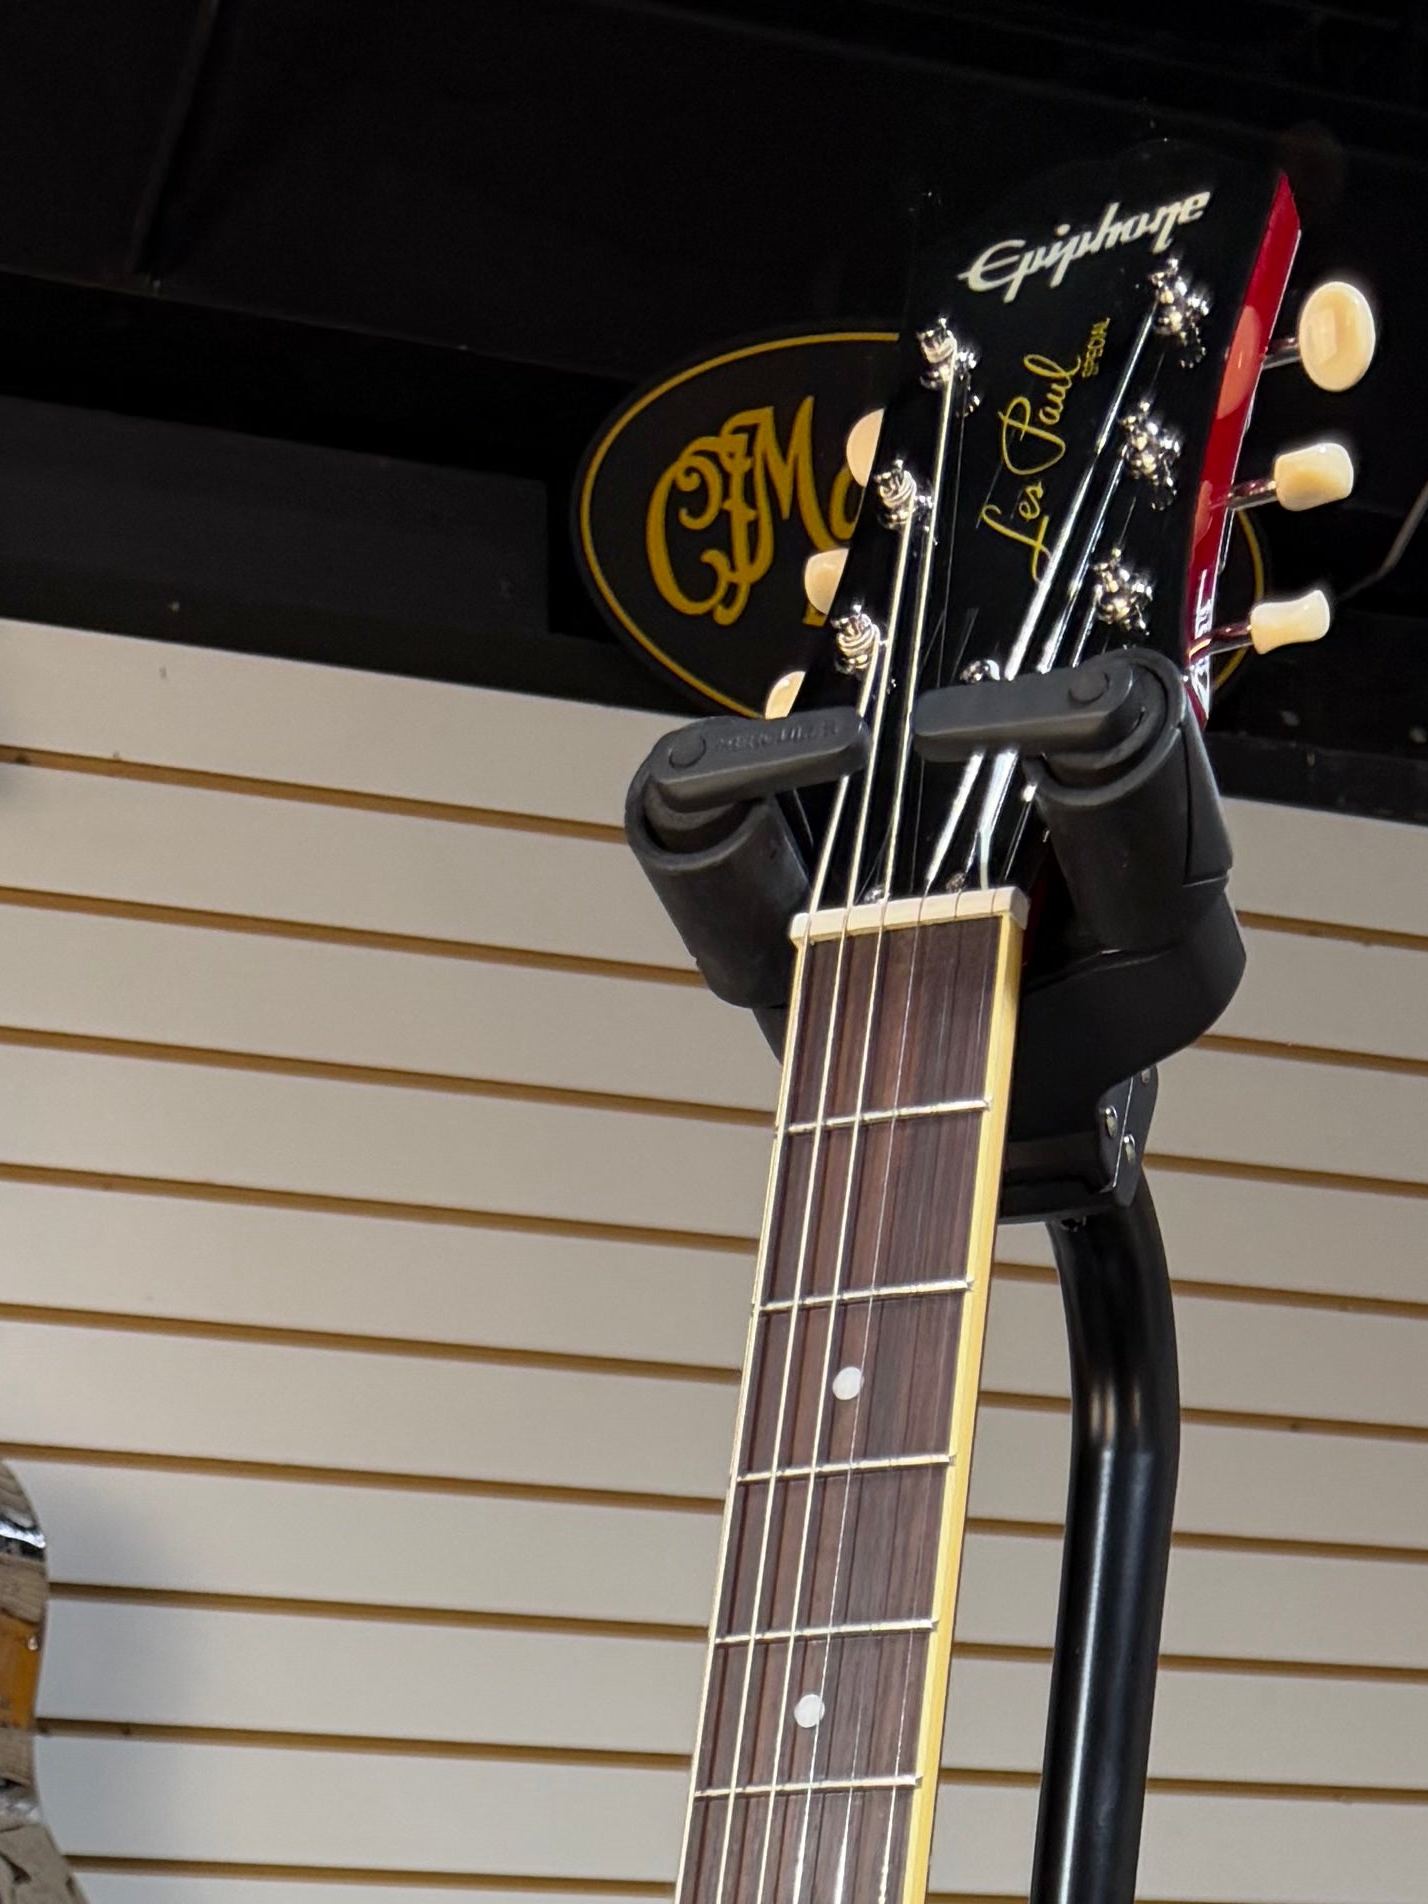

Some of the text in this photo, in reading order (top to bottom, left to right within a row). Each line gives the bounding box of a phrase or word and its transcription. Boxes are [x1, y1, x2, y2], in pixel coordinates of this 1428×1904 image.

[957, 191, 1211, 304] Epiphone
[997, 353, 1082, 477] Paul
[981, 479, 1053, 585] Les
